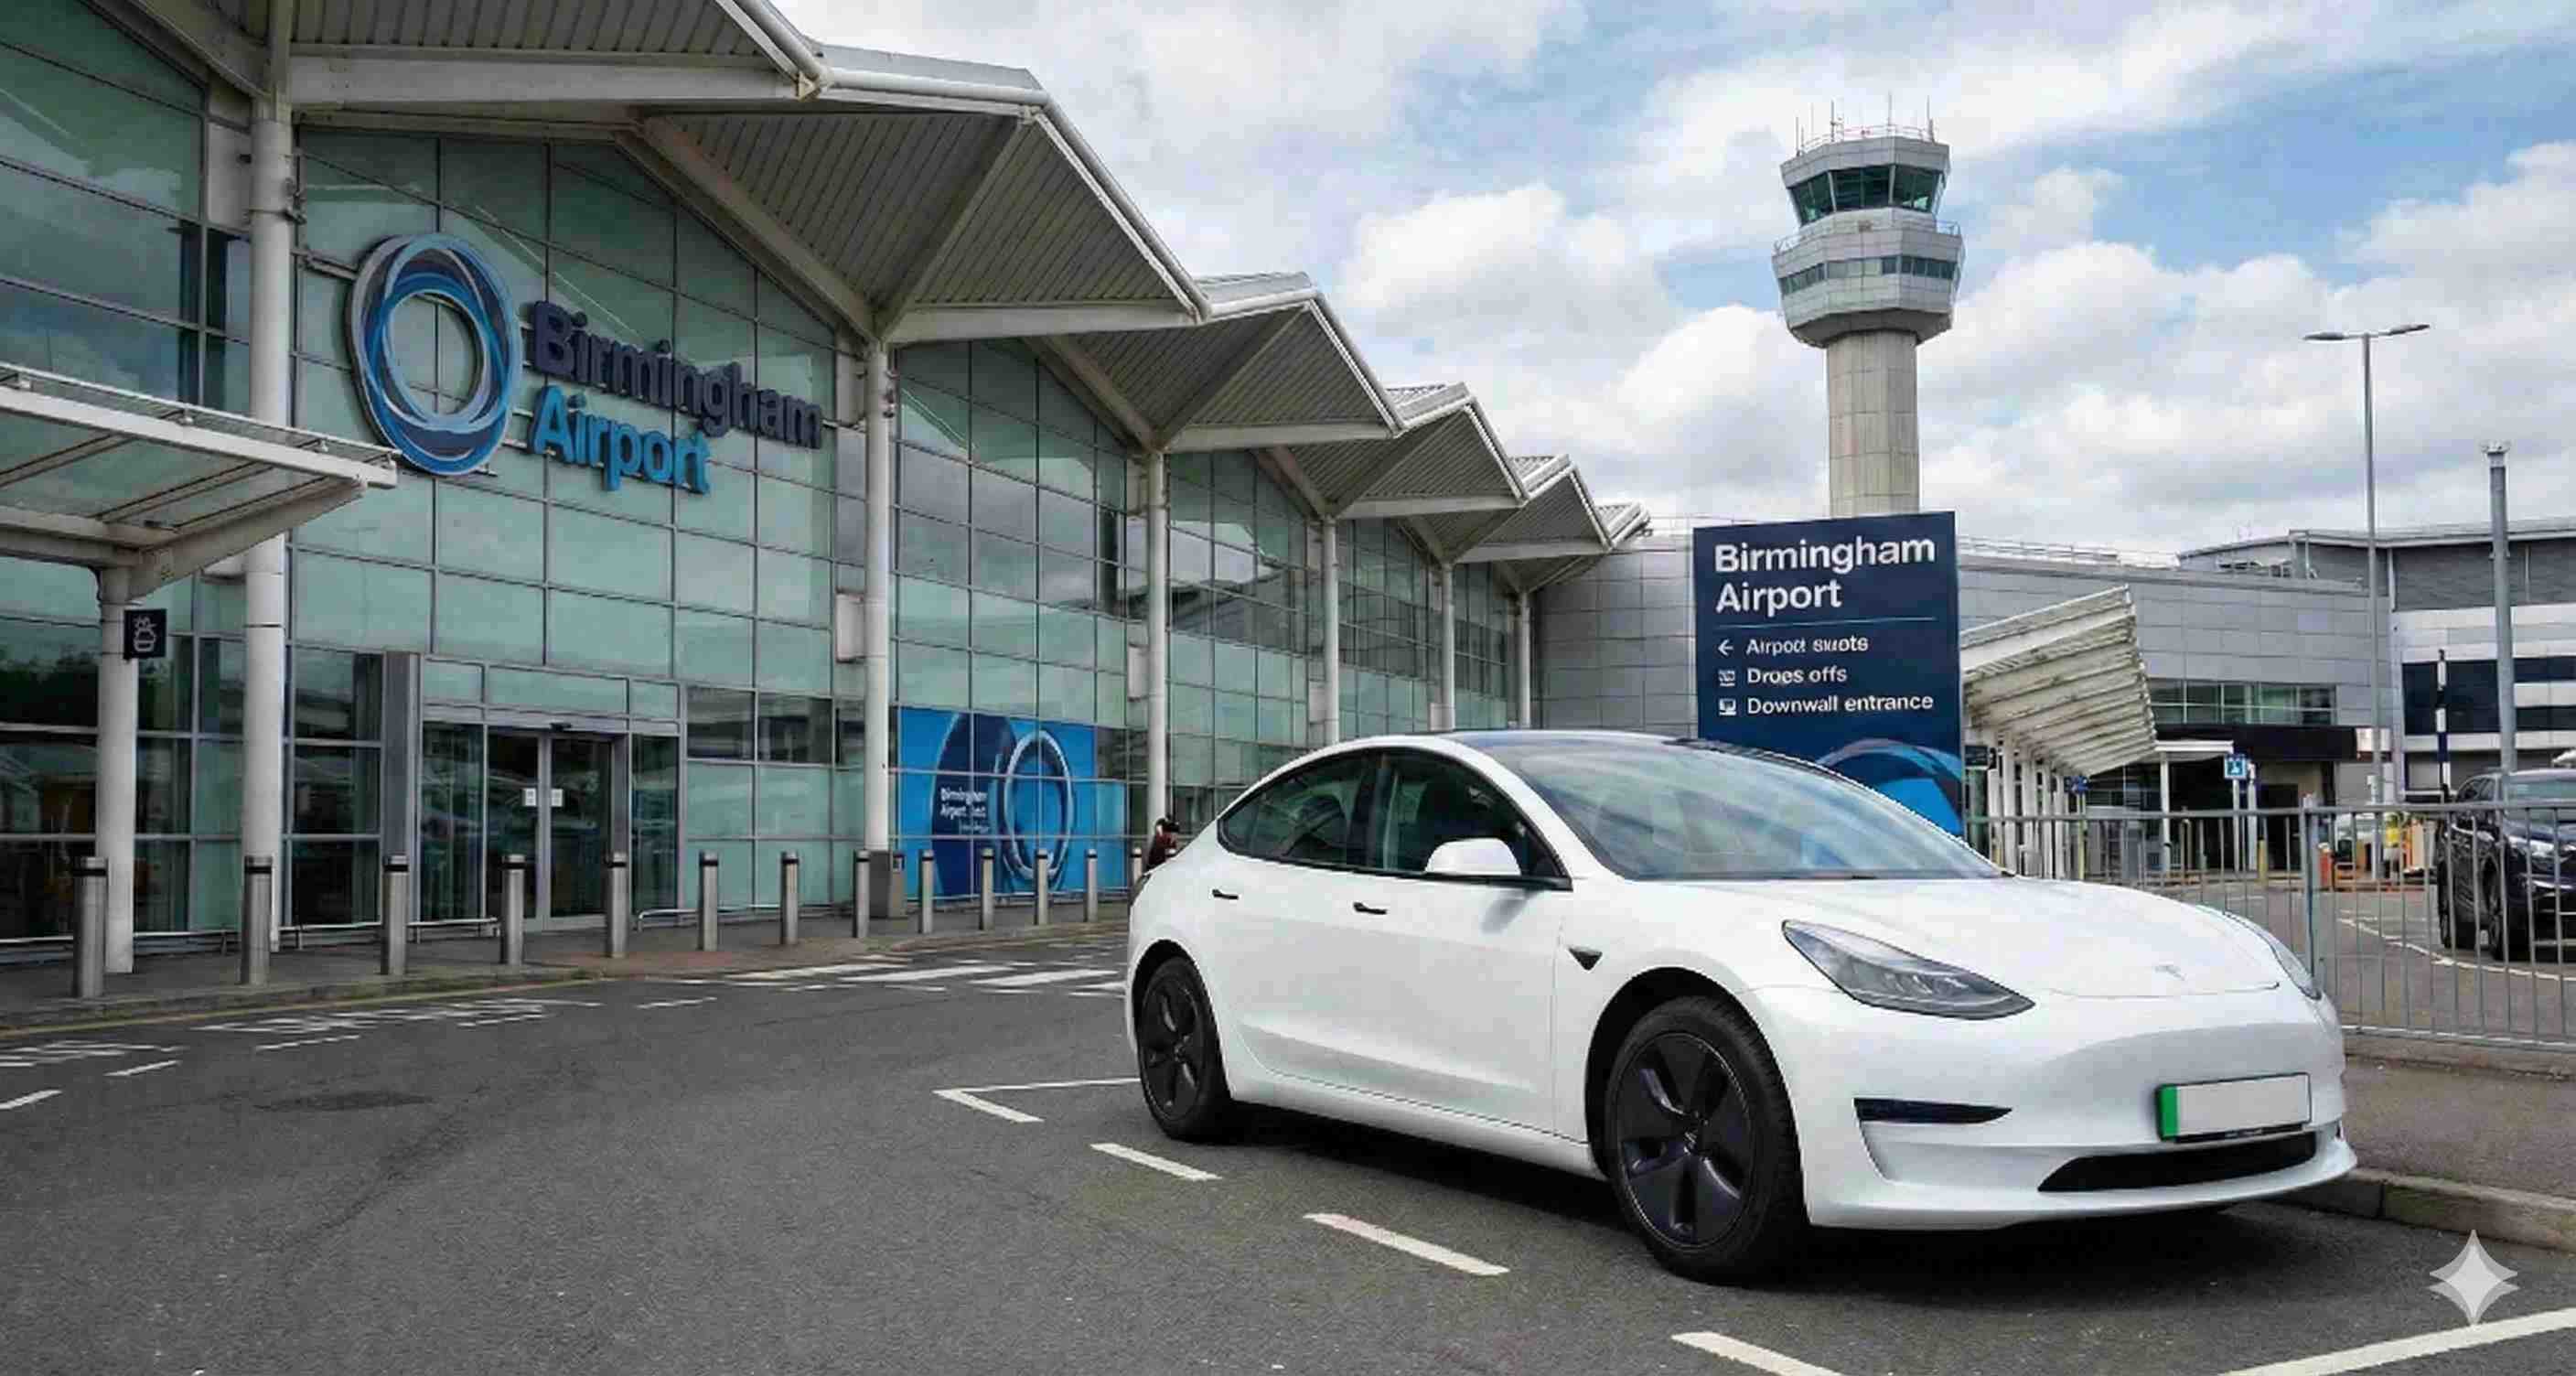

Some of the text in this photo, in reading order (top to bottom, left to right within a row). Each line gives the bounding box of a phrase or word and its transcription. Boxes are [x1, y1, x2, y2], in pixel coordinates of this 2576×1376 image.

[533, 300, 821, 449] Birmingham
[532, 384, 711, 495] Airport
[1714, 535, 1936, 574] Birmingham
[1715, 578, 1842, 618] Airport
[1809, 664, 1847, 683] offs
[1747, 694, 1934, 715] Downwall entrance
